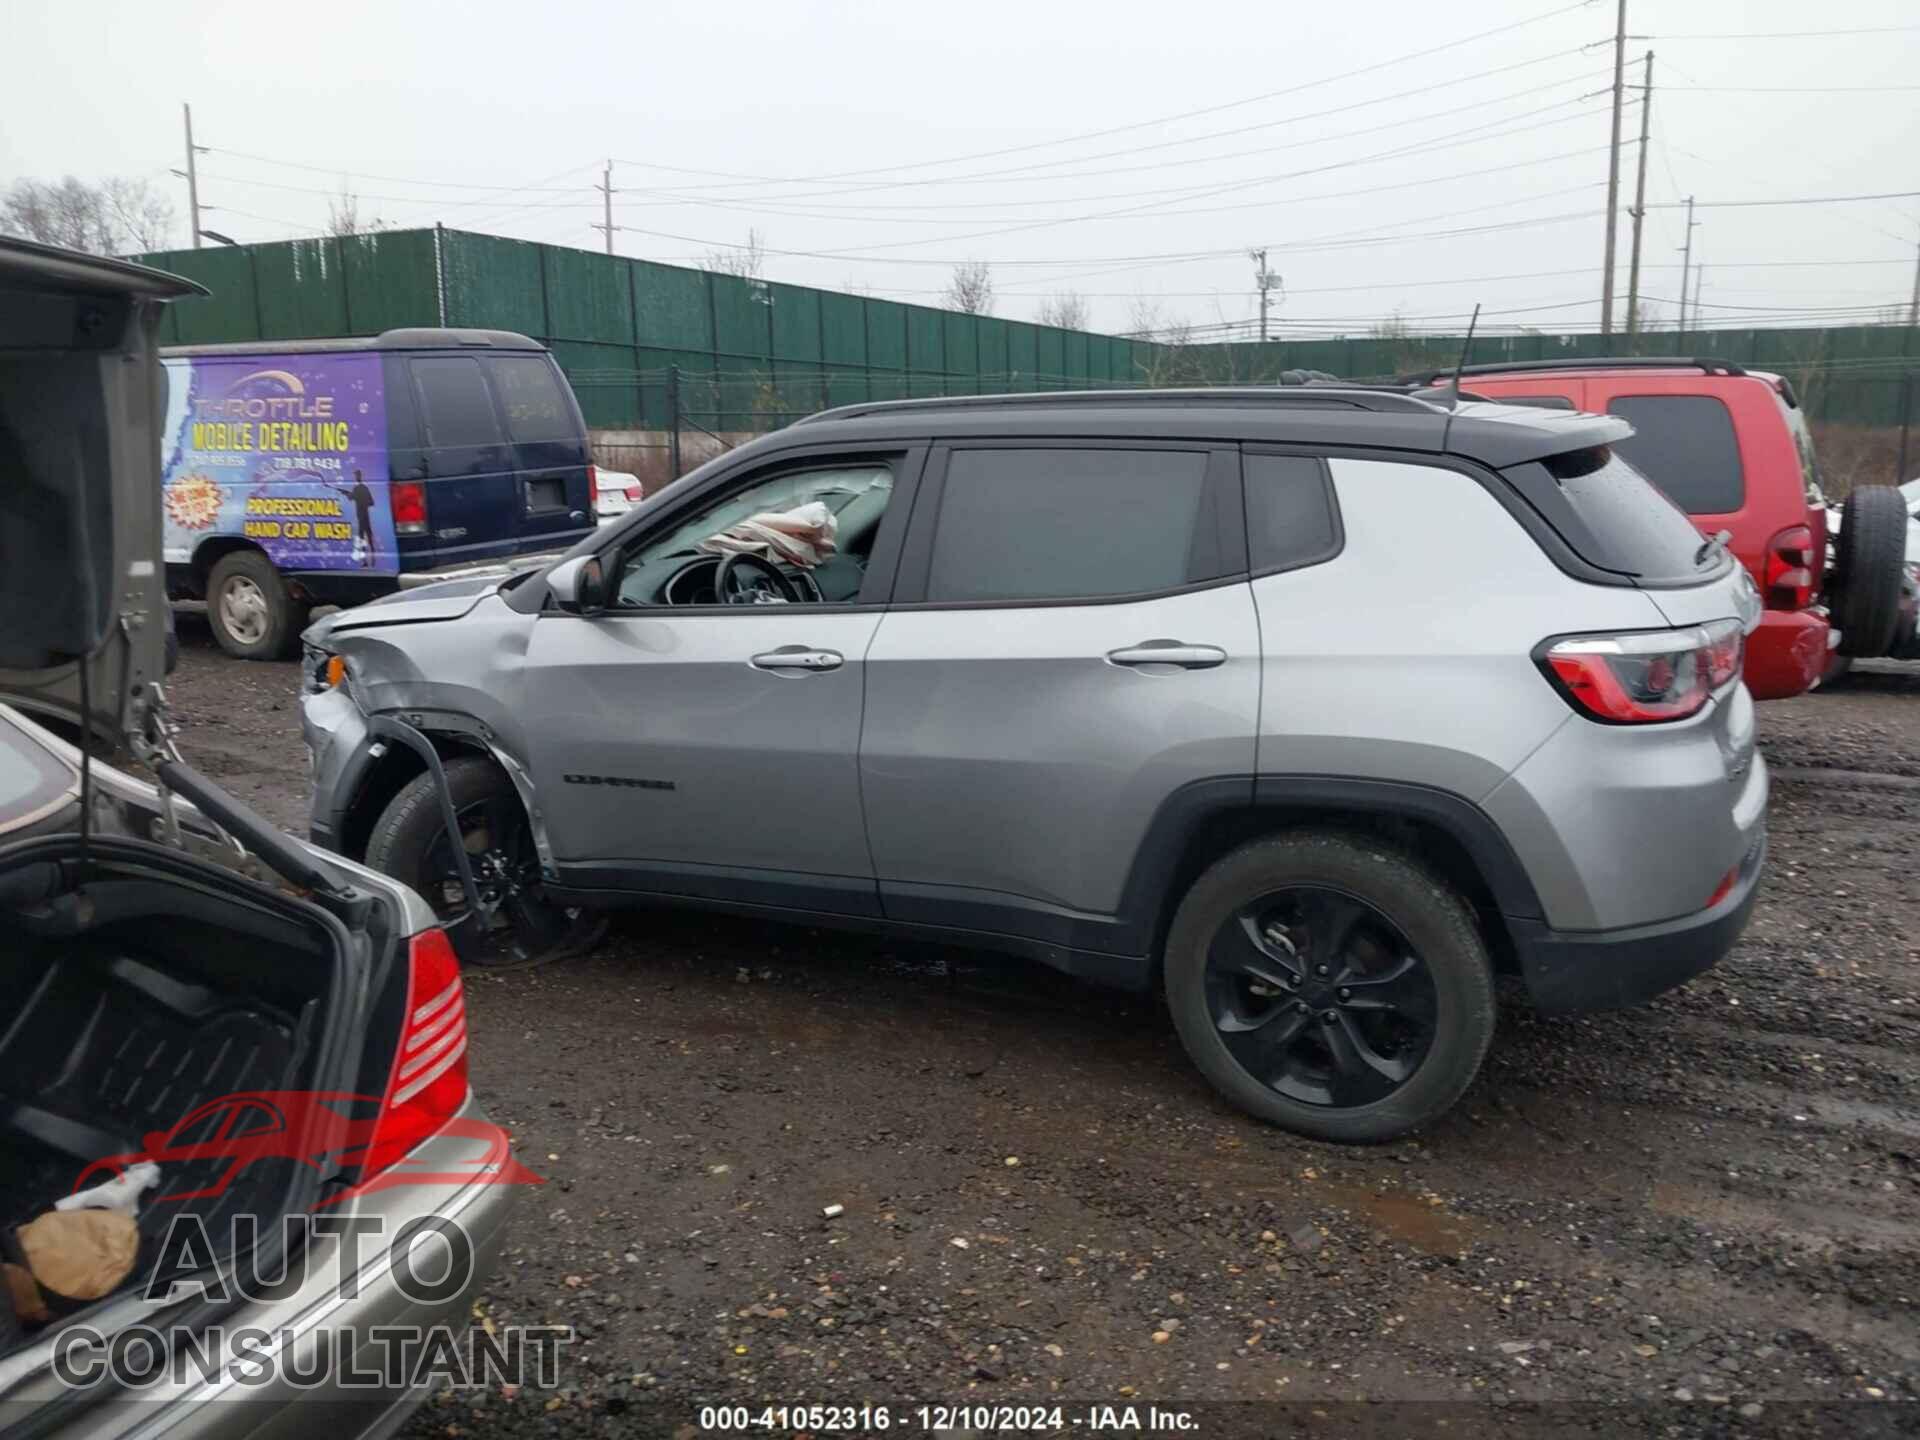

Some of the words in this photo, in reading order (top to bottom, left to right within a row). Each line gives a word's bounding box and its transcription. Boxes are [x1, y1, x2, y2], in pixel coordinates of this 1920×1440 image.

[194, 397, 335, 418] THROTTLE
[192, 421, 254, 451] MOBILE
[258, 421, 349, 452] DETAILING
[247, 498, 343, 516] PROFESSIONAL
[243, 520, 281, 538] HAND
[283, 521, 311, 539] CAR
[313, 522, 353, 540] WASH
